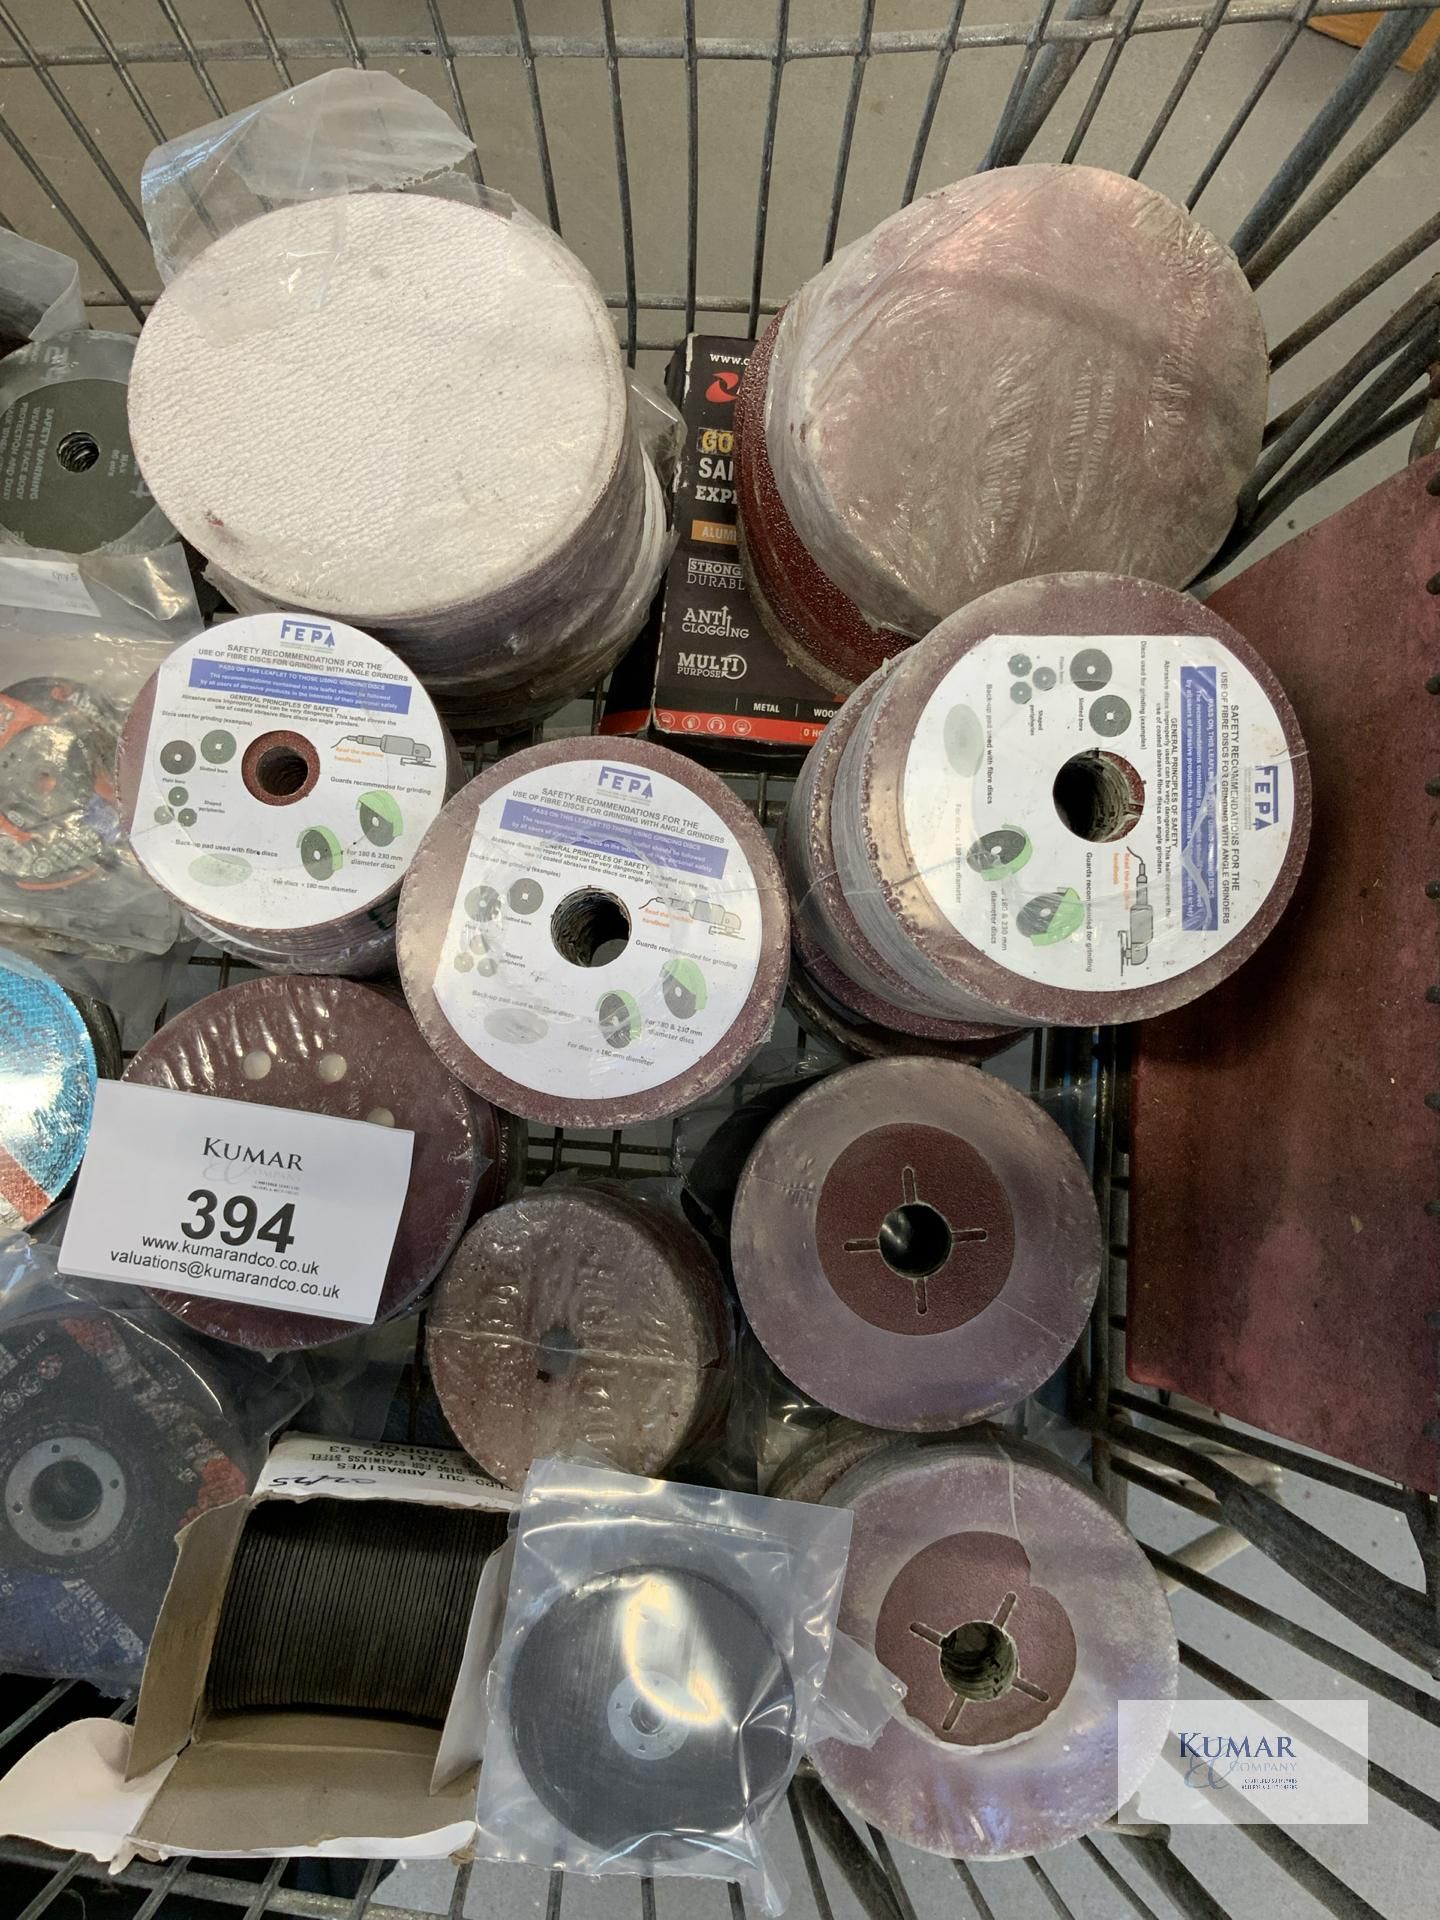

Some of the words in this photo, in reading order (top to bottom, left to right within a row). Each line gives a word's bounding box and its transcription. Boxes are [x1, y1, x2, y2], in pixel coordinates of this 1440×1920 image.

[10, 401, 27, 455] PROTECTION
[28, 406, 40, 431] WEAR
[38, 407, 54, 445] SAFETY
[702, 430, 734, 454] GO
[29, 446, 46, 500] WARNING
[690, 561, 742, 576] STRONG
[686, 573, 744, 590] DURABL
[280, 619, 336, 648] FEPA
[682, 617, 750, 639] CLOGGING
[198, 648, 212, 656] USE
[214, 650, 225, 658] OF
[226, 651, 247, 661] FIBRE
[248, 654, 271, 664] DISCS
[272, 657, 287, 666] FOR
[288, 660, 324, 671] GRINDING
[325, 664, 344, 673] WITH
[345, 667, 369, 677] ANGLE
[370, 670, 408, 682] GRINDERS
[226, 644, 260, 655] SAFETY
[261, 648, 345, 666] RECOMMENDATIONS
[346, 660, 364, 668] FOR
[365, 662, 382, 671] THE
[678, 652, 739, 672] MULTI
[677, 666, 721, 678] PURPOSE
[229, 693, 260, 703] GENERAL
[261, 697, 301, 708] PRINCIPLES
[313, 704, 338, 713] SAFETY
[753, 702, 780, 713] METAL
[1221, 691, 1228, 702] OF
[813, 709, 838, 718] WOO
[1230, 704, 1238, 742] SAFETY
[330, 776, 352, 784] Guards
[353, 779, 395, 789] recommended
[406, 786, 431, 795] grinding
[598, 765, 653, 799] FEPA
[1163, 779, 1170, 788] be
[541, 787, 575, 802] SAFETY
[574, 794, 661, 821] RECOMMENDATIONS
[661, 813, 680, 825] FOR
[681, 818, 699, 829] THE
[1170, 804, 1177, 815] OF
[1253, 766, 1279, 831] FEPA
[511, 790, 527, 800] USE
[527, 793, 539, 802] OF
[539, 796, 561, 807] FIBRE
[561, 801, 584, 812] DISCS
[585, 806, 602, 816] FOR
[601, 810, 639, 824] GRINDING
[639, 818, 659, 829] WITH
[659, 822, 685, 835] ANGLE
[685, 828, 725, 843] GRINDERS
[1155, 815, 1162, 824] on
[542, 855, 561, 863] coated
[562, 859, 587, 869] abrasive
[602, 868, 617, 876] discs
[627, 874, 643, 883] angle
[571, 848, 612, 862] PRINCIPLES
[612, 857, 622, 865] OF
[623, 859, 650, 871] SAFETY
[1230, 848, 1238, 868] FOR
[1230, 871, 1238, 890] THE
[1084, 943, 1092, 972] grinding
[202, 1136, 303, 1172] KUMAR
[180, 1189, 296, 1253] 394
[142, 1235, 319, 1275] www.kumarandco.co.uk
[110, 1250, 341, 1299] valuations@kumarandco.co.uk
[310, 1452, 341, 1461] STEEL
[347, 1454, 404, 1468] STAINLESS
[337, 1463, 427, 1477] ABRASIVES
[438, 1472, 466, 1482] CUT
